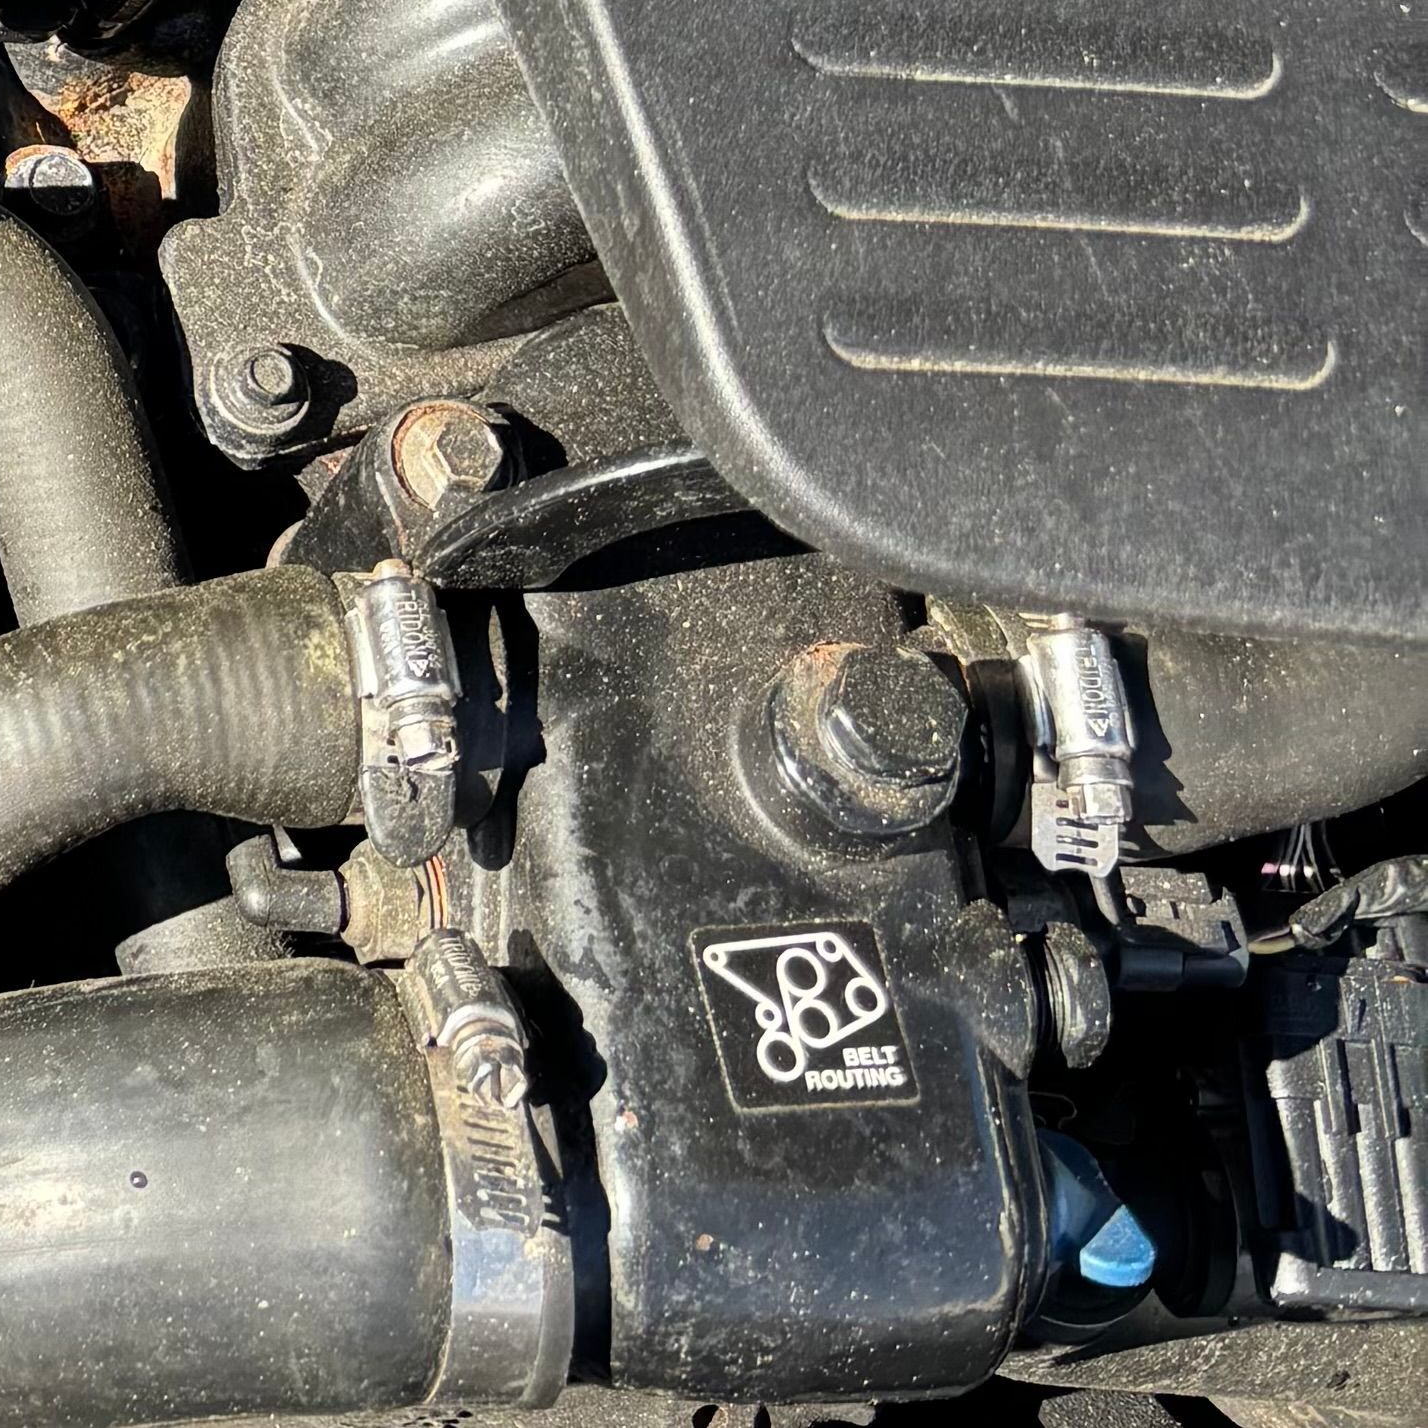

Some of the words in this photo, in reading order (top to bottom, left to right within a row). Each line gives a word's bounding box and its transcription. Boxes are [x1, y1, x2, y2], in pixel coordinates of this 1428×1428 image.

[394, 589, 429, 660] TRIDON
[842, 1045, 899, 1067] BELT
[804, 1066, 908, 1092] ROUTING
